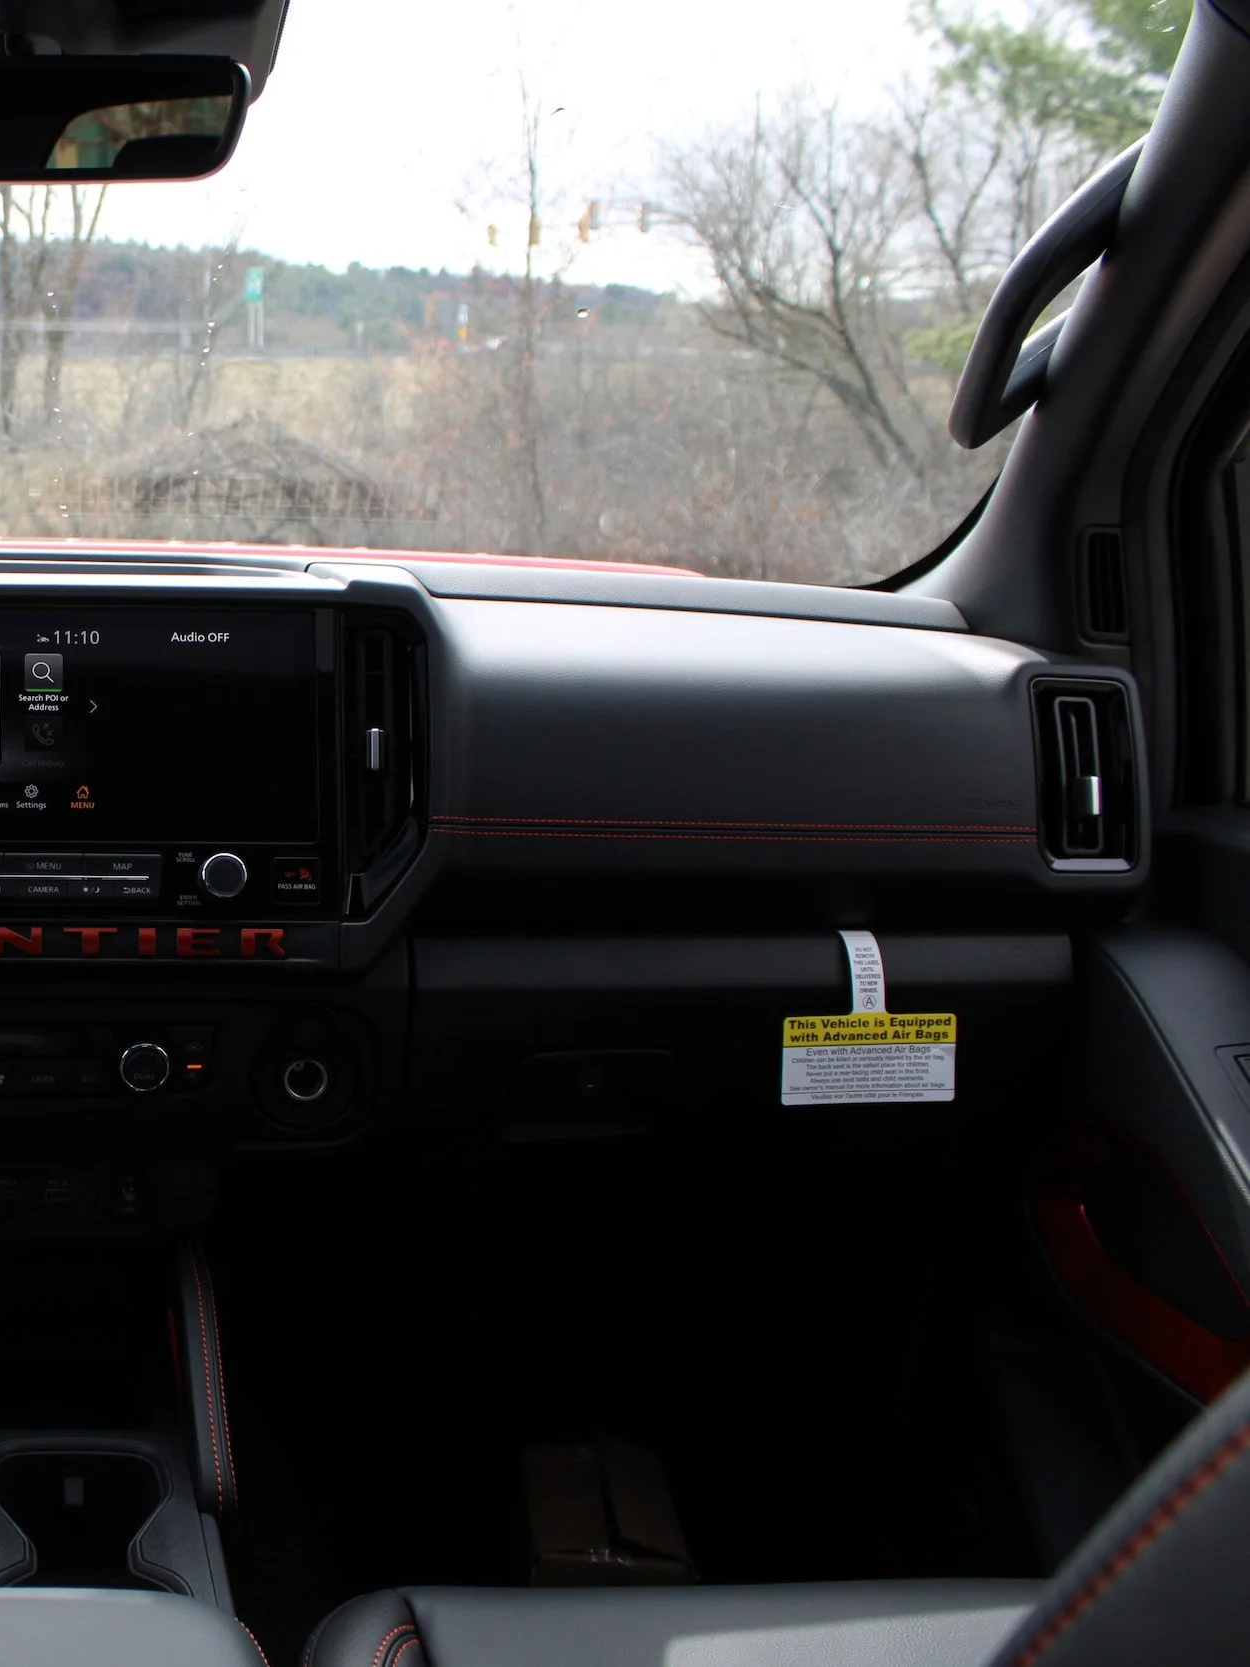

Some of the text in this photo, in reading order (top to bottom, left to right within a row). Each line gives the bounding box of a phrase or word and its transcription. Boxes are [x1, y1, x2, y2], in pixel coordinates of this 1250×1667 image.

[53, 630, 101, 645] 11:10
[170, 631, 231, 643] Audio OFF
[18, 693, 44, 702] Search
[44, 694, 59, 702] POI
[28, 703, 59, 711] Address
[37, 760, 65, 769] History
[15, 801, 47, 811] Settings
[70, 801, 96, 809] MENU
[36, 861, 62, 870] MENU
[112, 862, 133, 871] MAP
[27, 885, 60, 894] CAMERA
[130, 886, 152, 894] BACK
[788, 1016, 952, 1030] This Vehicle is Equipped
[790, 1029, 949, 1042] with Advanced Air Bags
[806, 1045, 931, 1056] Even with Advanced Air Bags
[133, 1072, 155, 1081] DUAL
